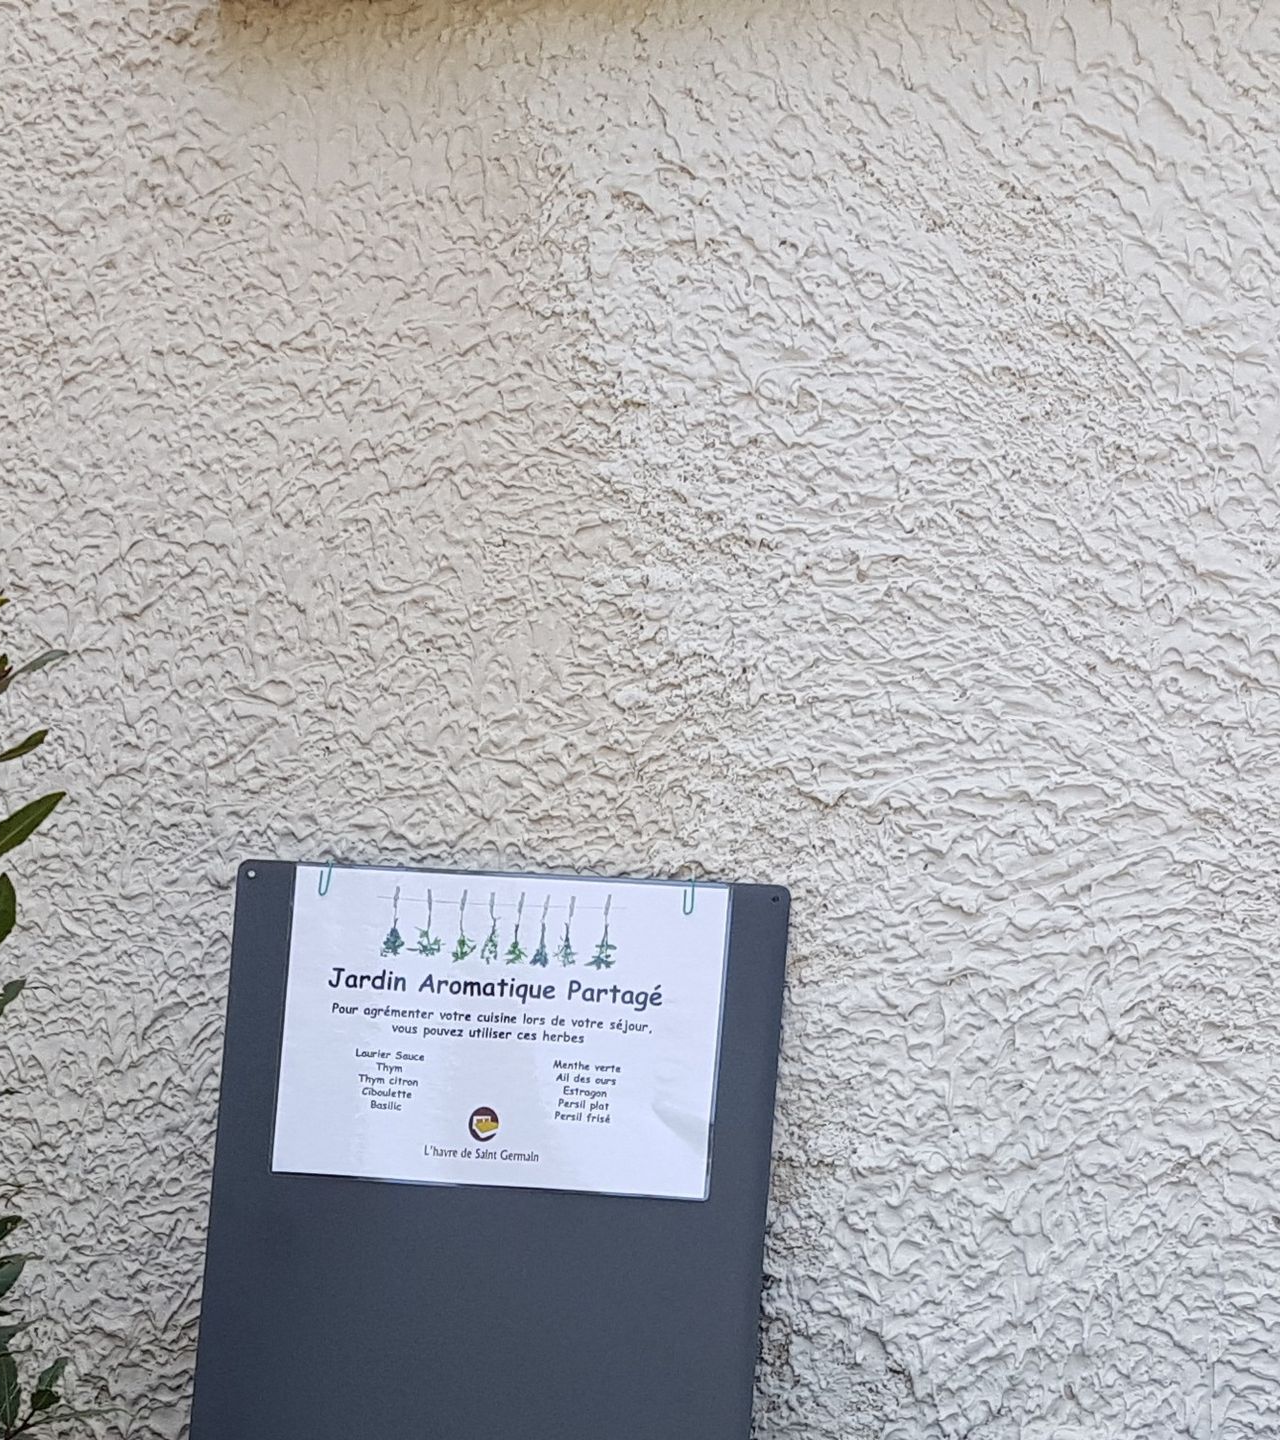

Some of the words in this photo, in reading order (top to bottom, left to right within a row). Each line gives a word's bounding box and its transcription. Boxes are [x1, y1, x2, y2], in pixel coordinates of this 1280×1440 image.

[327, 966, 407, 993] Jardin
[417, 973, 556, 1005] Aromatique
[567, 979, 663, 1013] Partagé
[331, 1001, 359, 1015] Pour
[362, 1004, 435, 1020] agrémenter
[439, 1010, 472, 1022] votre
[476, 1011, 517, 1024] cuisine
[522, 1012, 546, 1026] lors
[550, 1014, 566, 1027] de
[570, 1017, 604, 1030] votre
[609, 1018, 653, 1035] séjour,
[391, 1024, 418, 1035] vous
[422, 1026, 465, 1039] pouvez
[468, 1026, 513, 1040] utiliser
[516, 1031, 537, 1041] ces
[542, 1029, 585, 1044] herbes
[355, 1047, 392, 1059] Laurier
[394, 1050, 425, 1062] Sauce
[375, 1061, 403, 1076] Thym
[552, 1059, 590, 1072] Menthe
[594, 1064, 622, 1074] verte
[357, 1073, 386, 1087] Thym
[388, 1075, 419, 1087] citron
[555, 1072, 570, 1083] Ail
[573, 1073, 591, 1084] des
[594, 1077, 617, 1086] ours
[361, 1086, 413, 1099] Ciboulette
[562, 1085, 608, 1100] Estragon
[370, 1099, 403, 1112] Basilic
[557, 1097, 586, 1110] Persil
[589, 1100, 610, 1113] plat
[554, 1110, 583, 1122] Persil
[423, 1144, 459, 1159] L'havre
[460, 1147, 473, 1160] de
[474, 1147, 497, 1161] Saint
[499, 1148, 540, 1163] Germain
